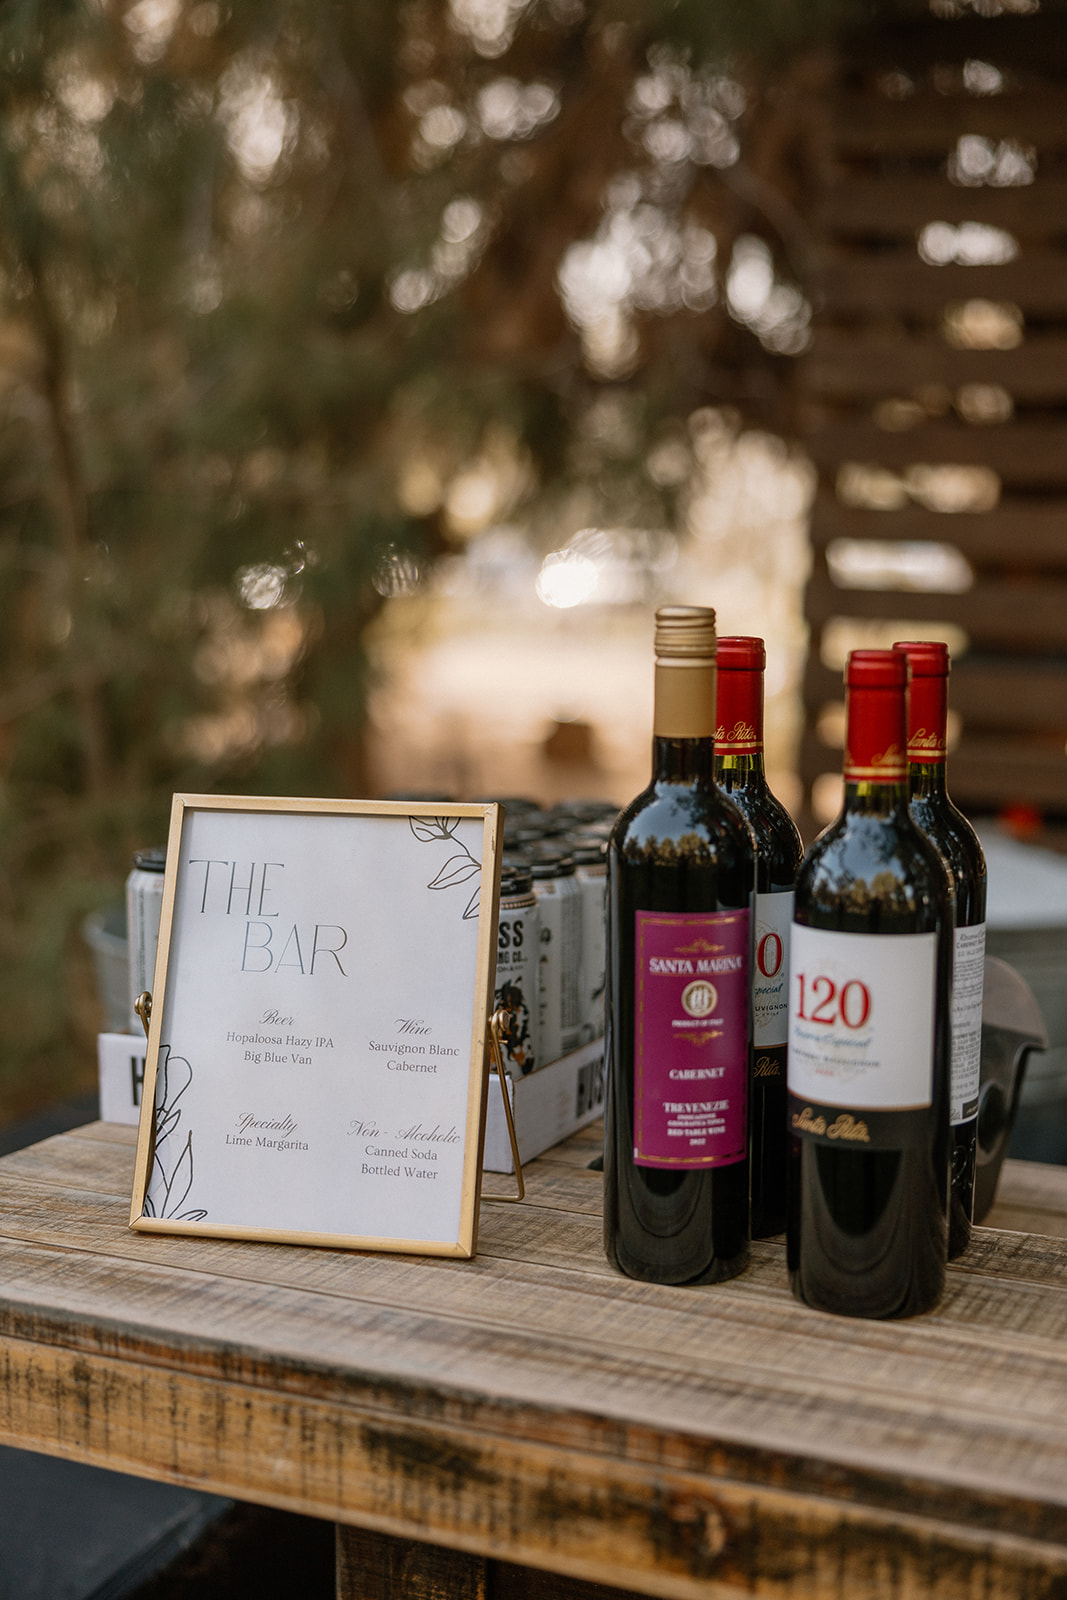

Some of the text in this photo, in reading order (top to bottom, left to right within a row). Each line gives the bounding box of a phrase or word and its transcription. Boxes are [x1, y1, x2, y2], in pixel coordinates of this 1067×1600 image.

[727, 721, 755, 741] Rita
[189, 859, 285, 917] THE
[241, 921, 349, 978] BAR
[649, 955, 742, 974] SANTA MARINA
[796, 972, 871, 1030] 120
[258, 1009, 297, 1027] Beer
[394, 1017, 434, 1036] Wine
[226, 1030, 334, 1050] Hopaloosa Hazy IPA
[368, 1040, 460, 1058] Sauvignon Blanc
[243, 1050, 312, 1065] Big Blue Van
[386, 1060, 438, 1075] Cabernet
[669, 1067, 725, 1080] CABERNET
[662, 1100, 729, 1113] TREVENEZIE
[234, 1112, 299, 1138] Specialty
[395, 1123, 462, 1144] Alcoholic
[667, 1125, 726, 1136] RED TABLE WINE
[225, 1134, 309, 1152] Lime Margarita
[365, 1145, 438, 1161] Canned Soda
[361, 1164, 439, 1180] Bottled Water
